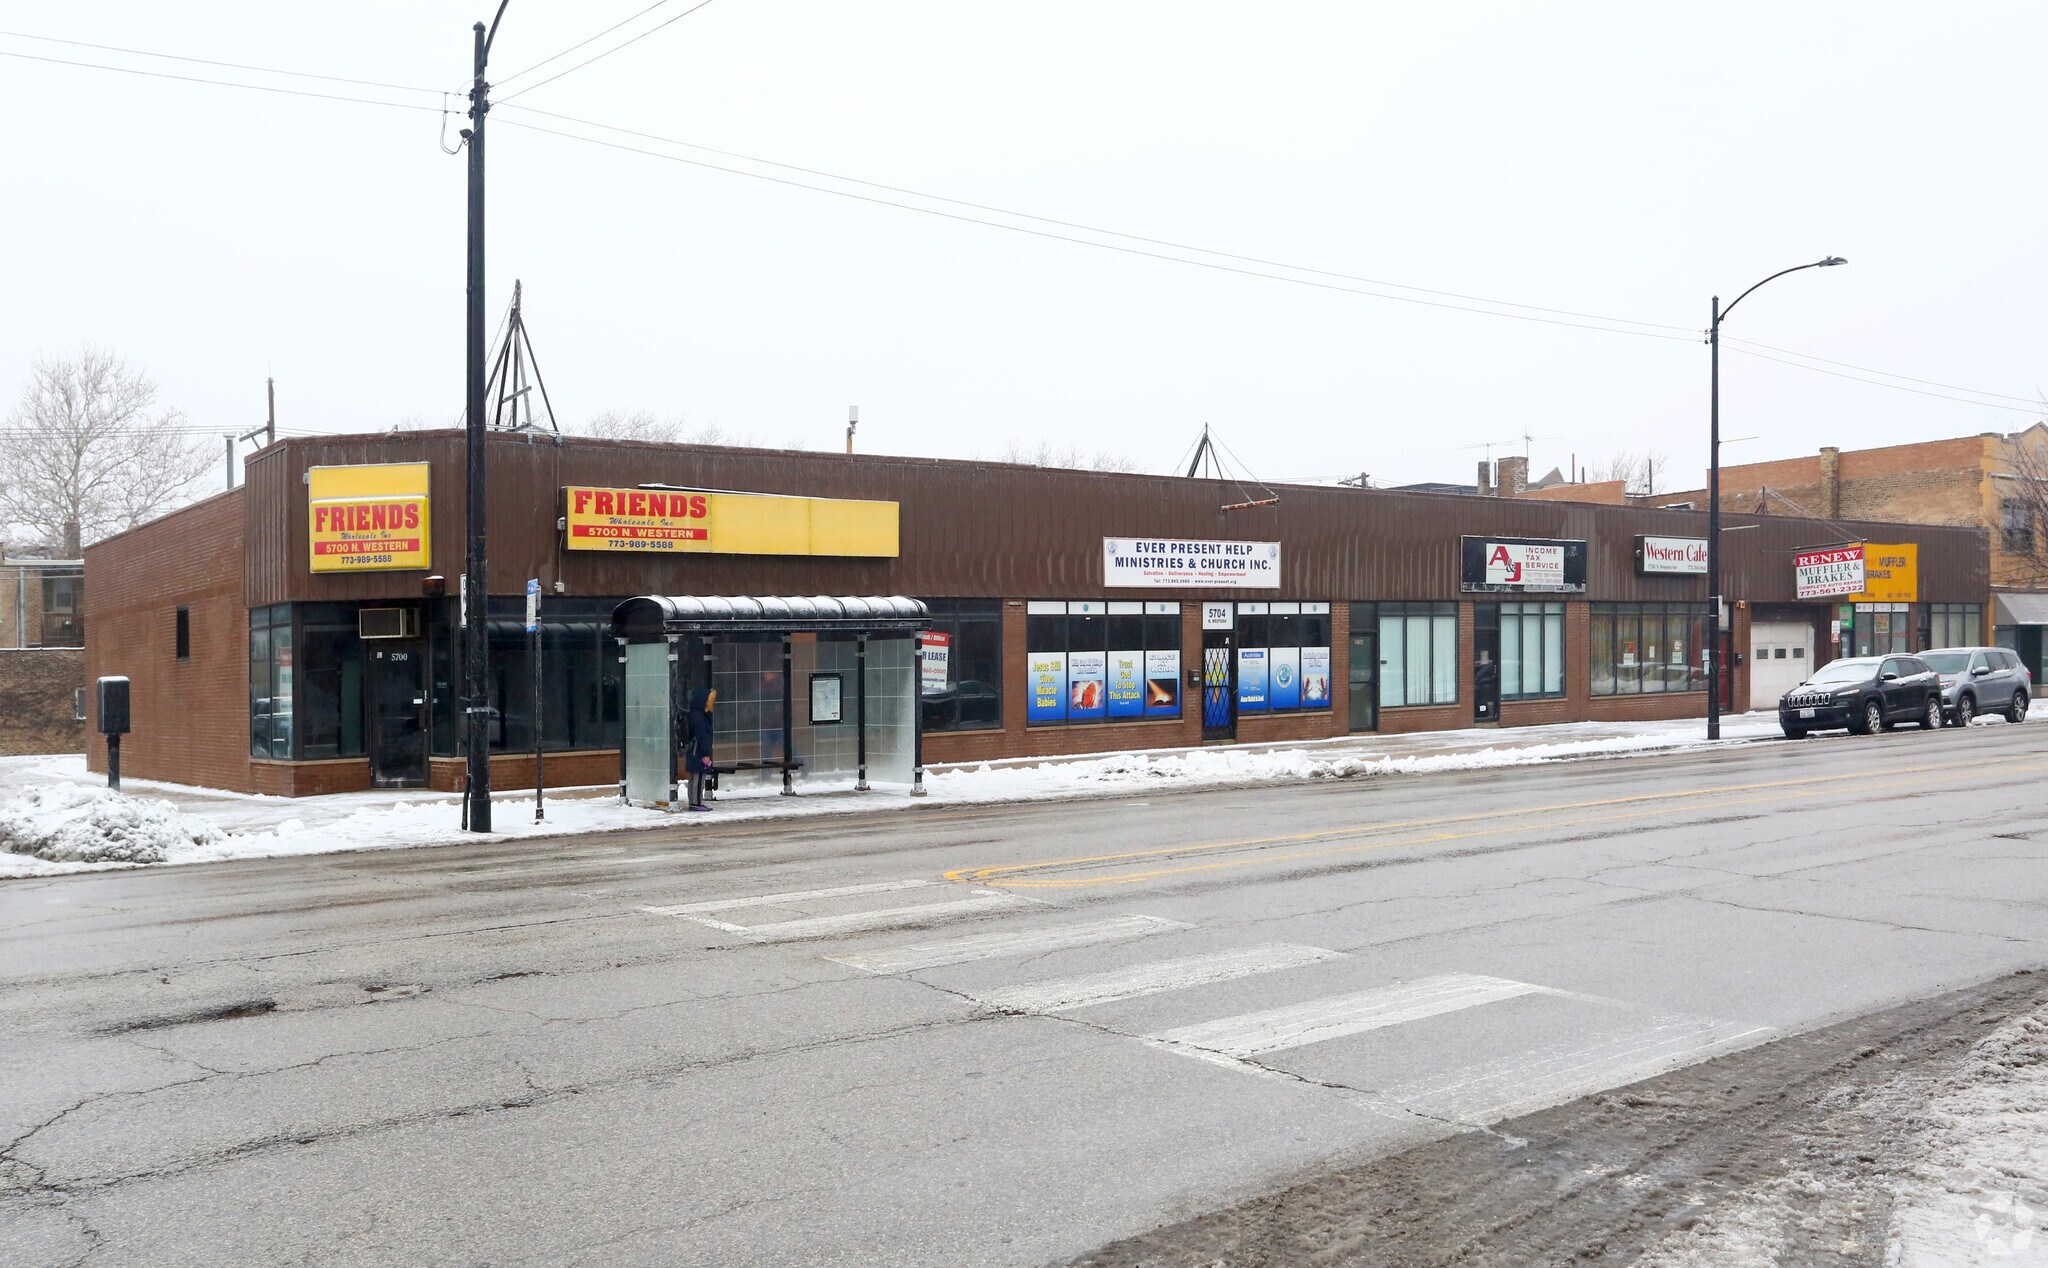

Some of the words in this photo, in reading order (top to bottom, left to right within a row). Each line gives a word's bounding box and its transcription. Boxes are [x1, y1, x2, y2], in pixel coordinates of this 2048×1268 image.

[574, 490, 707, 519] FRIENDS
[315, 503, 419, 533] FRIENDS
[608, 517, 655, 526] Wholesale
[660, 518, 674, 527] Inc
[340, 532, 377, 540] Wholesale
[380, 531, 392, 539] Inc
[588, 527, 618, 537] 5700
[622, 528, 633, 537] N.
[637, 529, 694, 539] WESTERN
[326, 544, 349, 553] 5700
[351, 543, 360, 552] N.
[363, 541, 409, 552] WESTERN
[608, 540, 674, 549] 773-989-5588
[1136, 542, 1166, 554] EVER
[1171, 542, 1222, 555] PRESENT
[1226, 544, 1253, 556] HELP
[1525, 547, 1558, 555] INCOME
[1645, 541, 1684, 561] Western
[1686, 543, 1707, 562] Cafe
[341, 554, 392, 564] 773-989-5588
[1798, 549, 1861, 567] RENEW
[1878, 556, 1907, 568] MUFFLER
[1115, 556, 1184, 569] MINISTRIES
[1188, 558, 1197, 569] &
[1200, 558, 1246, 570] CHURCH
[1250, 559, 1272, 571] INC.
[1525, 562, 1559, 570] SERVICE
[1799, 563, 1851, 577] MUFFLER
[1852, 562, 1861, 571] &
[1866, 569, 1891, 579] BRAKES
[1807, 571, 1853, 585] BRAKES
[1799, 584, 1864, 597] 773-561-2322
[1208, 608, 1226, 618] 5704
[391, 652, 408, 661] 5700
[928, 651, 947, 662] LEASE
[1032, 662, 1049, 672] Jesus
[1050, 661, 1061, 671] Still
[1118, 659, 1133, 669] Trust
[1039, 674, 1055, 683] Gives
[1120, 669, 1131, 679] God
[1036, 685, 1057, 695] Miracle
[1115, 681, 1122, 689] To
[1123, 680, 1136, 690] Stop
[1109, 692, 1121, 700] This
[1122, 691, 1141, 700] Attack
[1037, 697, 1057, 708] Babies
